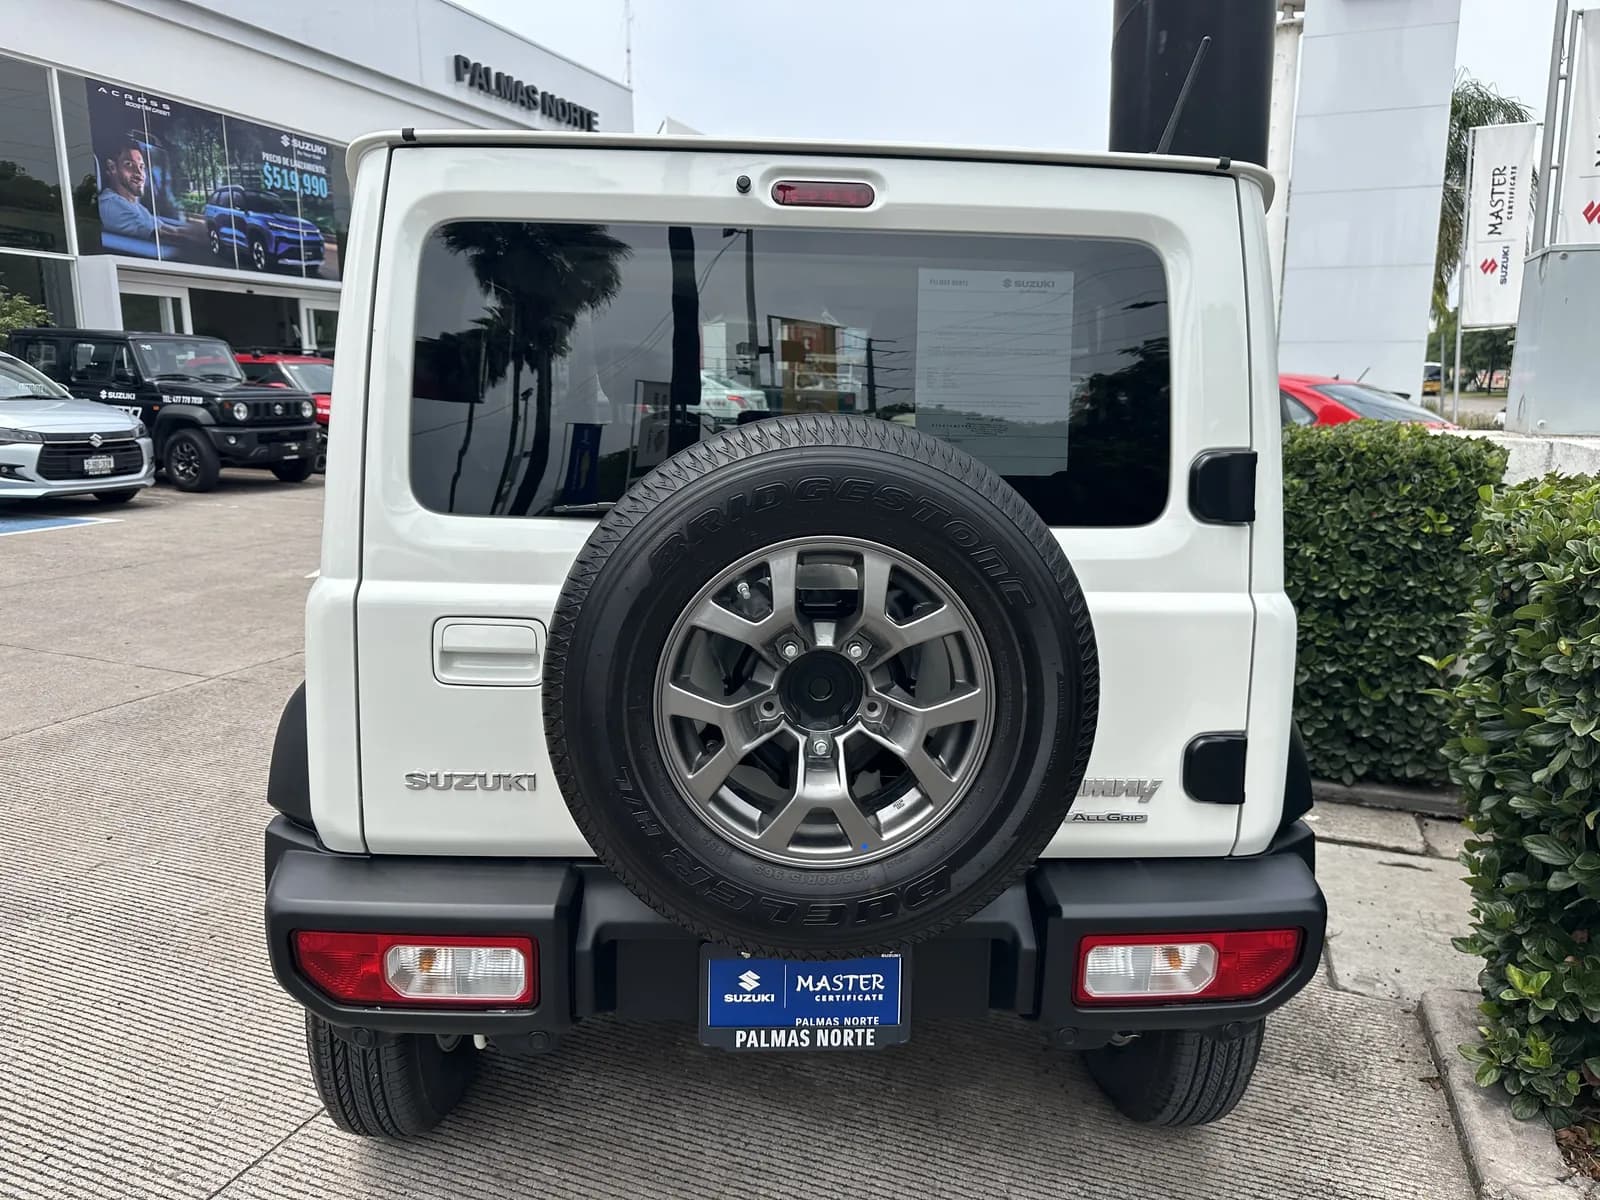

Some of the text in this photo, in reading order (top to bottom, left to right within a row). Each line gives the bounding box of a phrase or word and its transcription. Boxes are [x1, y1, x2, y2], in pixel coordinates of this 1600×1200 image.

[97, 87, 171, 110] ACROSS
[454, 54, 600, 133] PALMAS NORTE
[291, 138, 327, 155] SUZUKI
[262, 152, 281, 164] PRECIO
[263, 161, 328, 199] $519,990
[1487, 165, 1507, 236] MASTER
[1507, 165, 1518, 220] CERTIFICATE
[1500, 246, 1510, 285] SUZUKI
[1014, 280, 1055, 288] SUZUKI
[107, 391, 136, 400] SUZUKI
[648, 474, 1038, 610] BRIDGESTONE
[405, 771, 537, 792] SUZUKI
[613, 765, 665, 838] H/L
[752, 863, 870, 888] 195/80R15 96S
[660, 846, 952, 928] DUELER
[796, 973, 885, 992] MASTER
[724, 993, 775, 1003] SUZUKI
[815, 993, 884, 1002] CERTIFICATE
[795, 1016, 880, 1027] PALMAS NORTE
[735, 1028, 876, 1048] PALMAS NORTE
